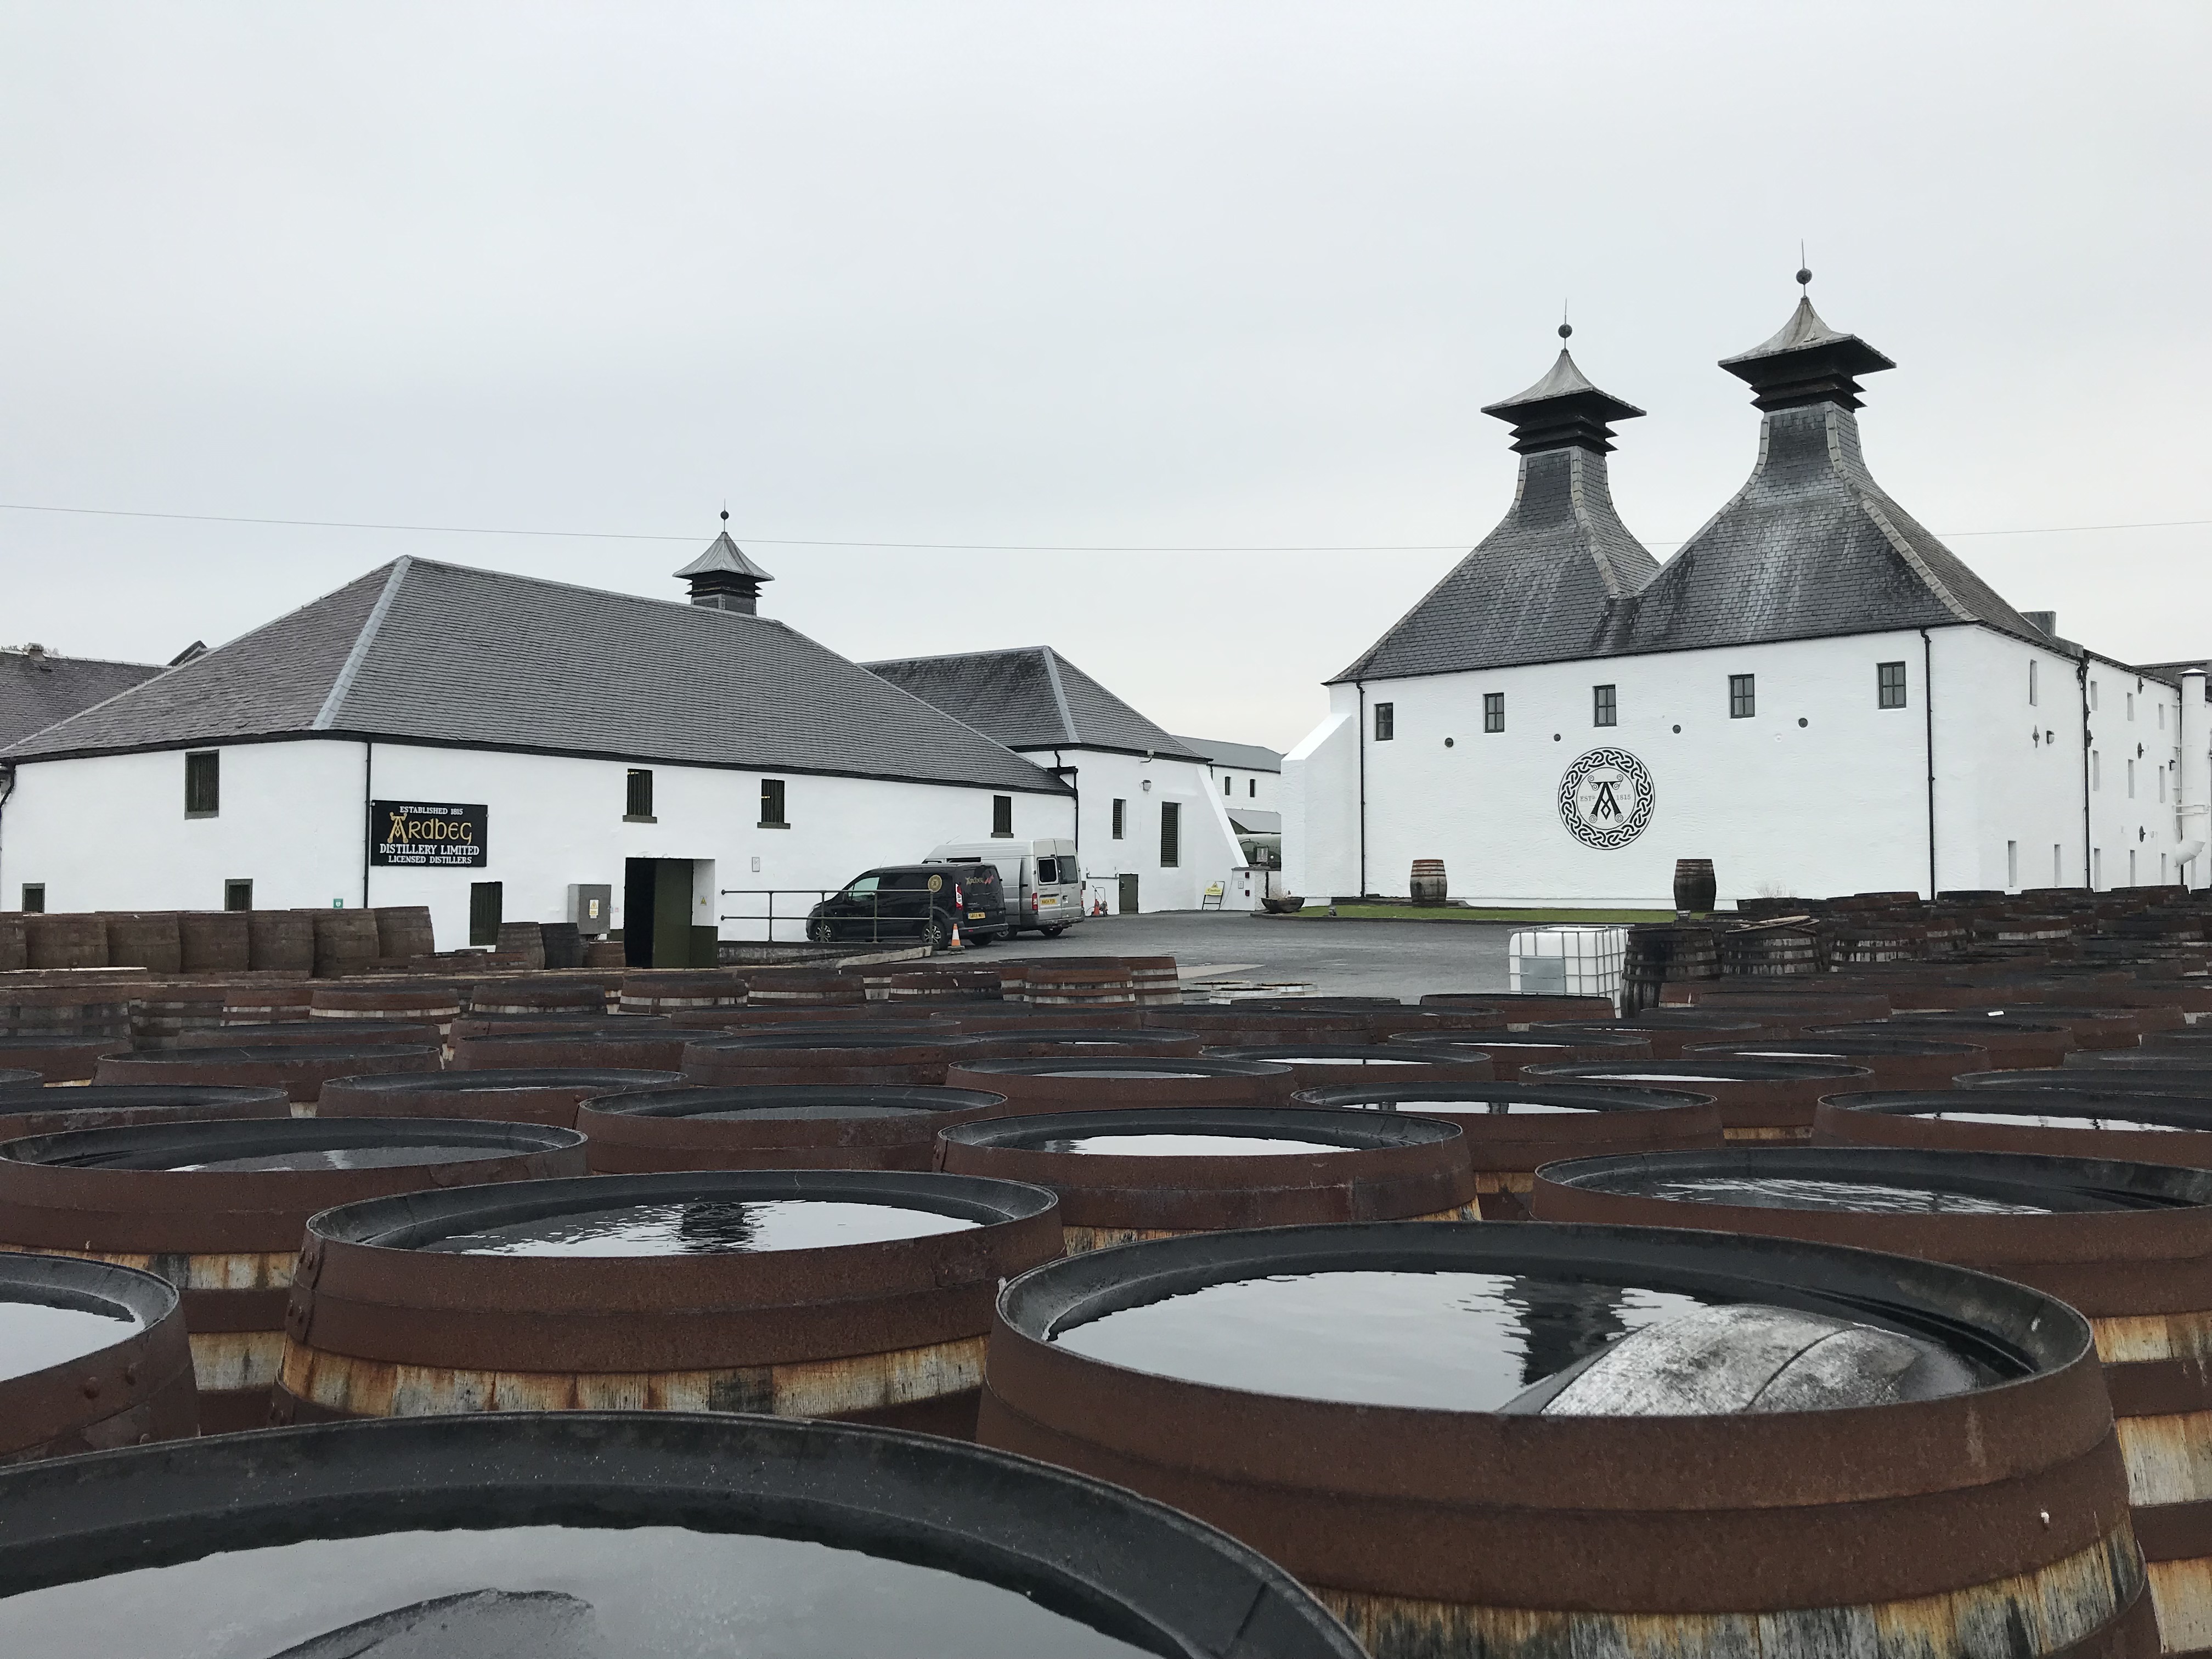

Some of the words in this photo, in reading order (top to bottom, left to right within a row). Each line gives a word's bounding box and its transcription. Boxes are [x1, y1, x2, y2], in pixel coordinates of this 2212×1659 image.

[399, 806, 448, 815] ESTABLISHED
[380, 843, 437, 855] DISTILLERY
[441, 845, 480, 856] LIMITED
[388, 855, 426, 864] LICENSED
[429, 856, 472, 864] DISTILLERS
